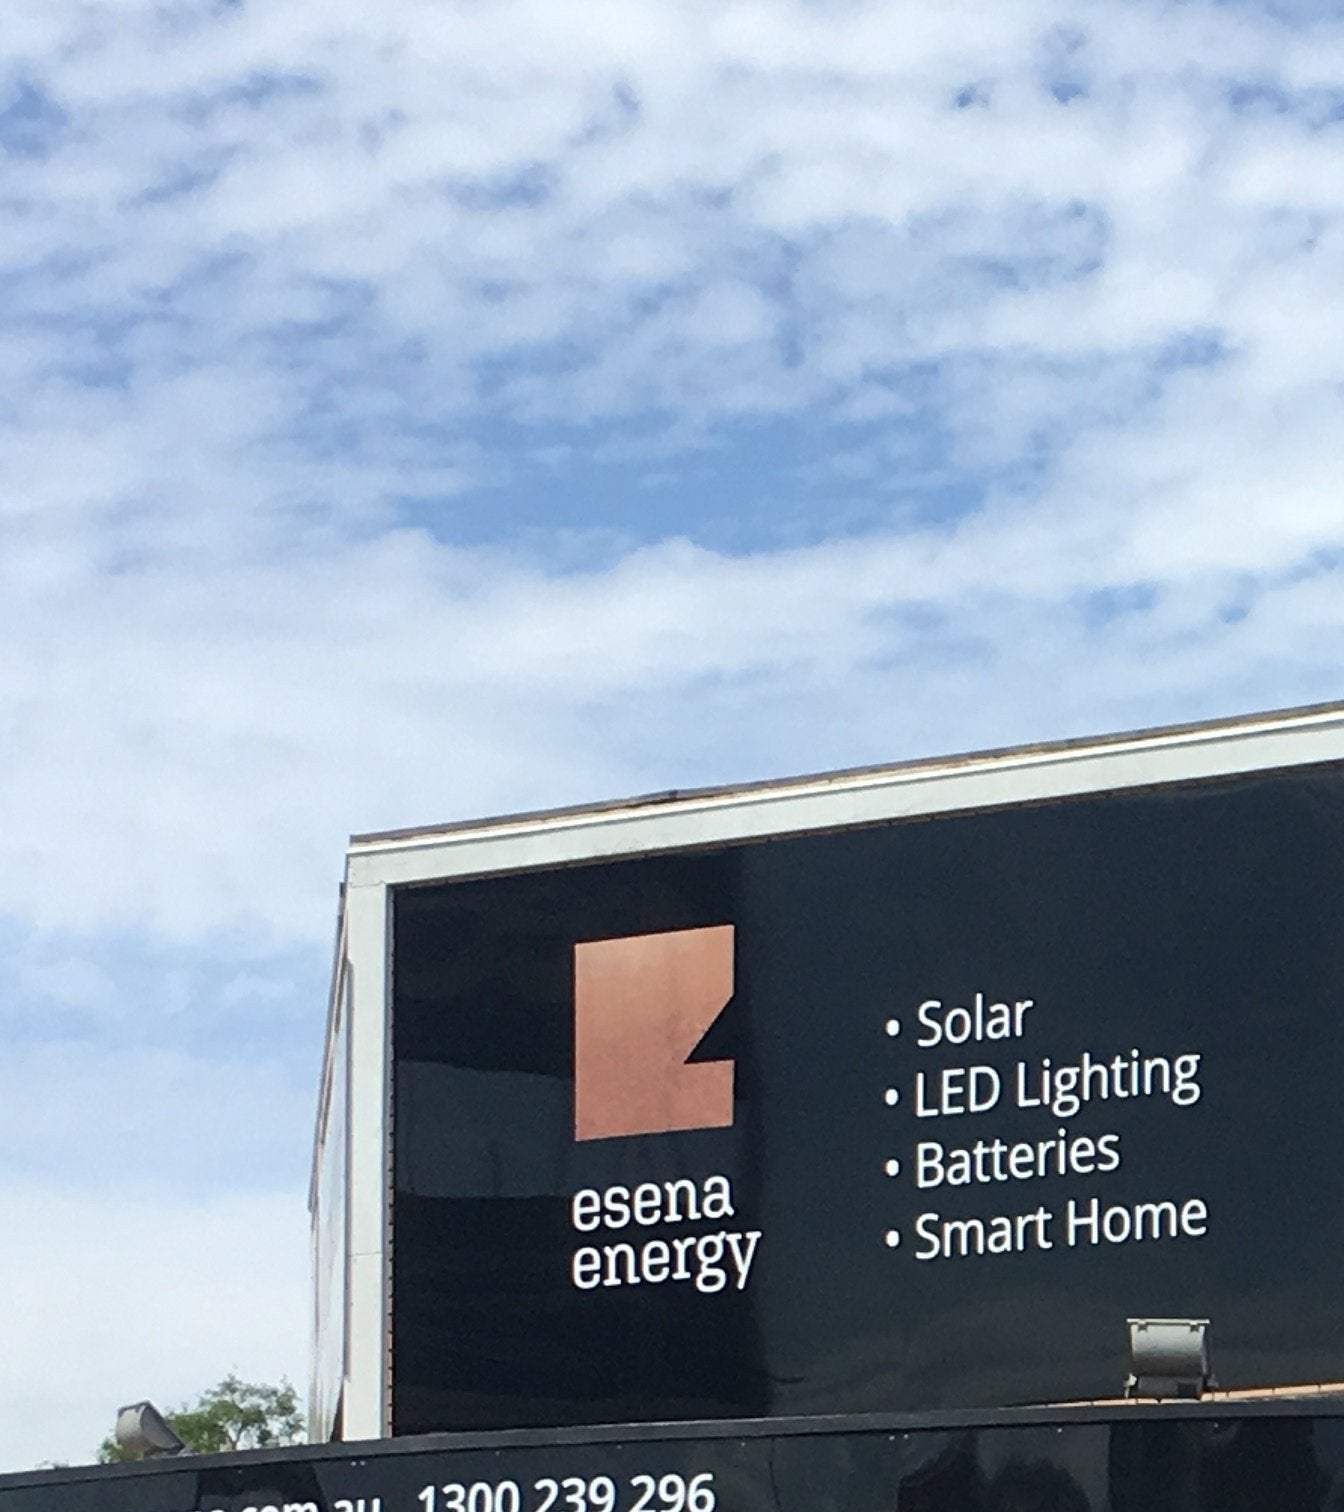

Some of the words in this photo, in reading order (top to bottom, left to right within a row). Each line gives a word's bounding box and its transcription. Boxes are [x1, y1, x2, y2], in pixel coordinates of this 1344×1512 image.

[917, 992, 1034, 1047] Solar
[916, 1065, 1001, 1118] LED
[1015, 1047, 1202, 1118] Lighting
[917, 1127, 1120, 1189] Batteries
[571, 1175, 735, 1232] esena
[915, 1206, 1053, 1260] Smart
[1067, 1197, 1207, 1246] Home
[571, 1229, 762, 1294] energy
